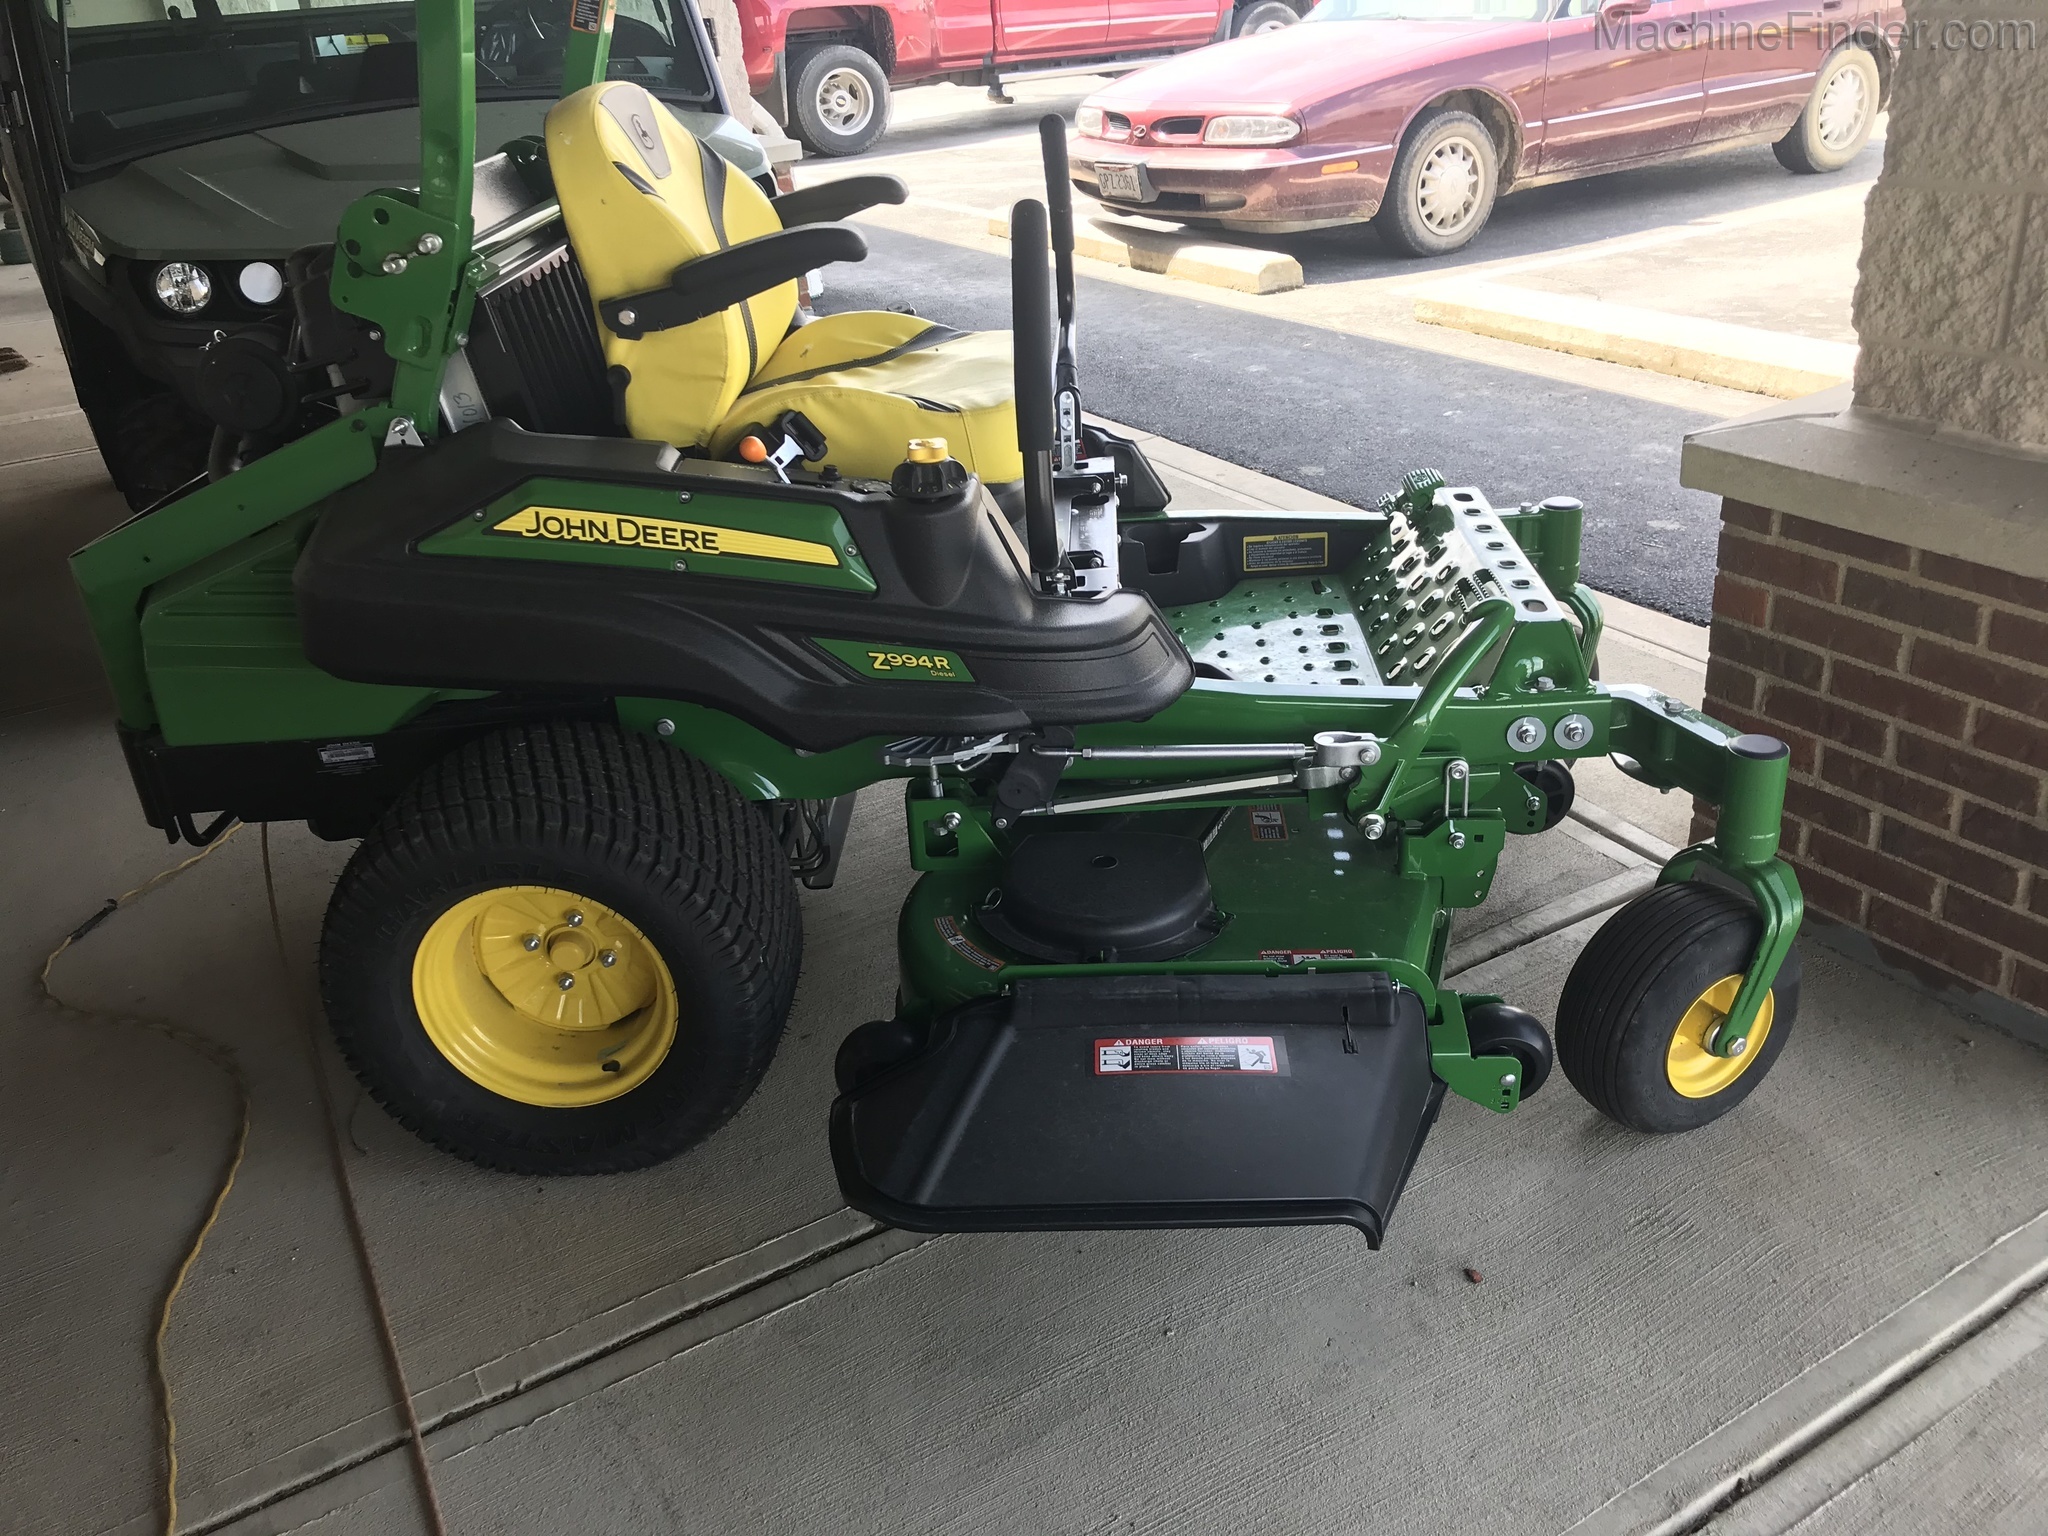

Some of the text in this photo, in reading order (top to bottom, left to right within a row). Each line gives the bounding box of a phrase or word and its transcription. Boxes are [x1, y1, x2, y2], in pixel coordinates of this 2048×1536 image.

[525, 510, 720, 552] JOHN DEERE
[866, 650, 952, 671] Z994R
[930, 669, 956, 678] Diesel
[1125, 1038, 1163, 1046] DANGER
[1208, 1037, 1249, 1045] PELIGRO
